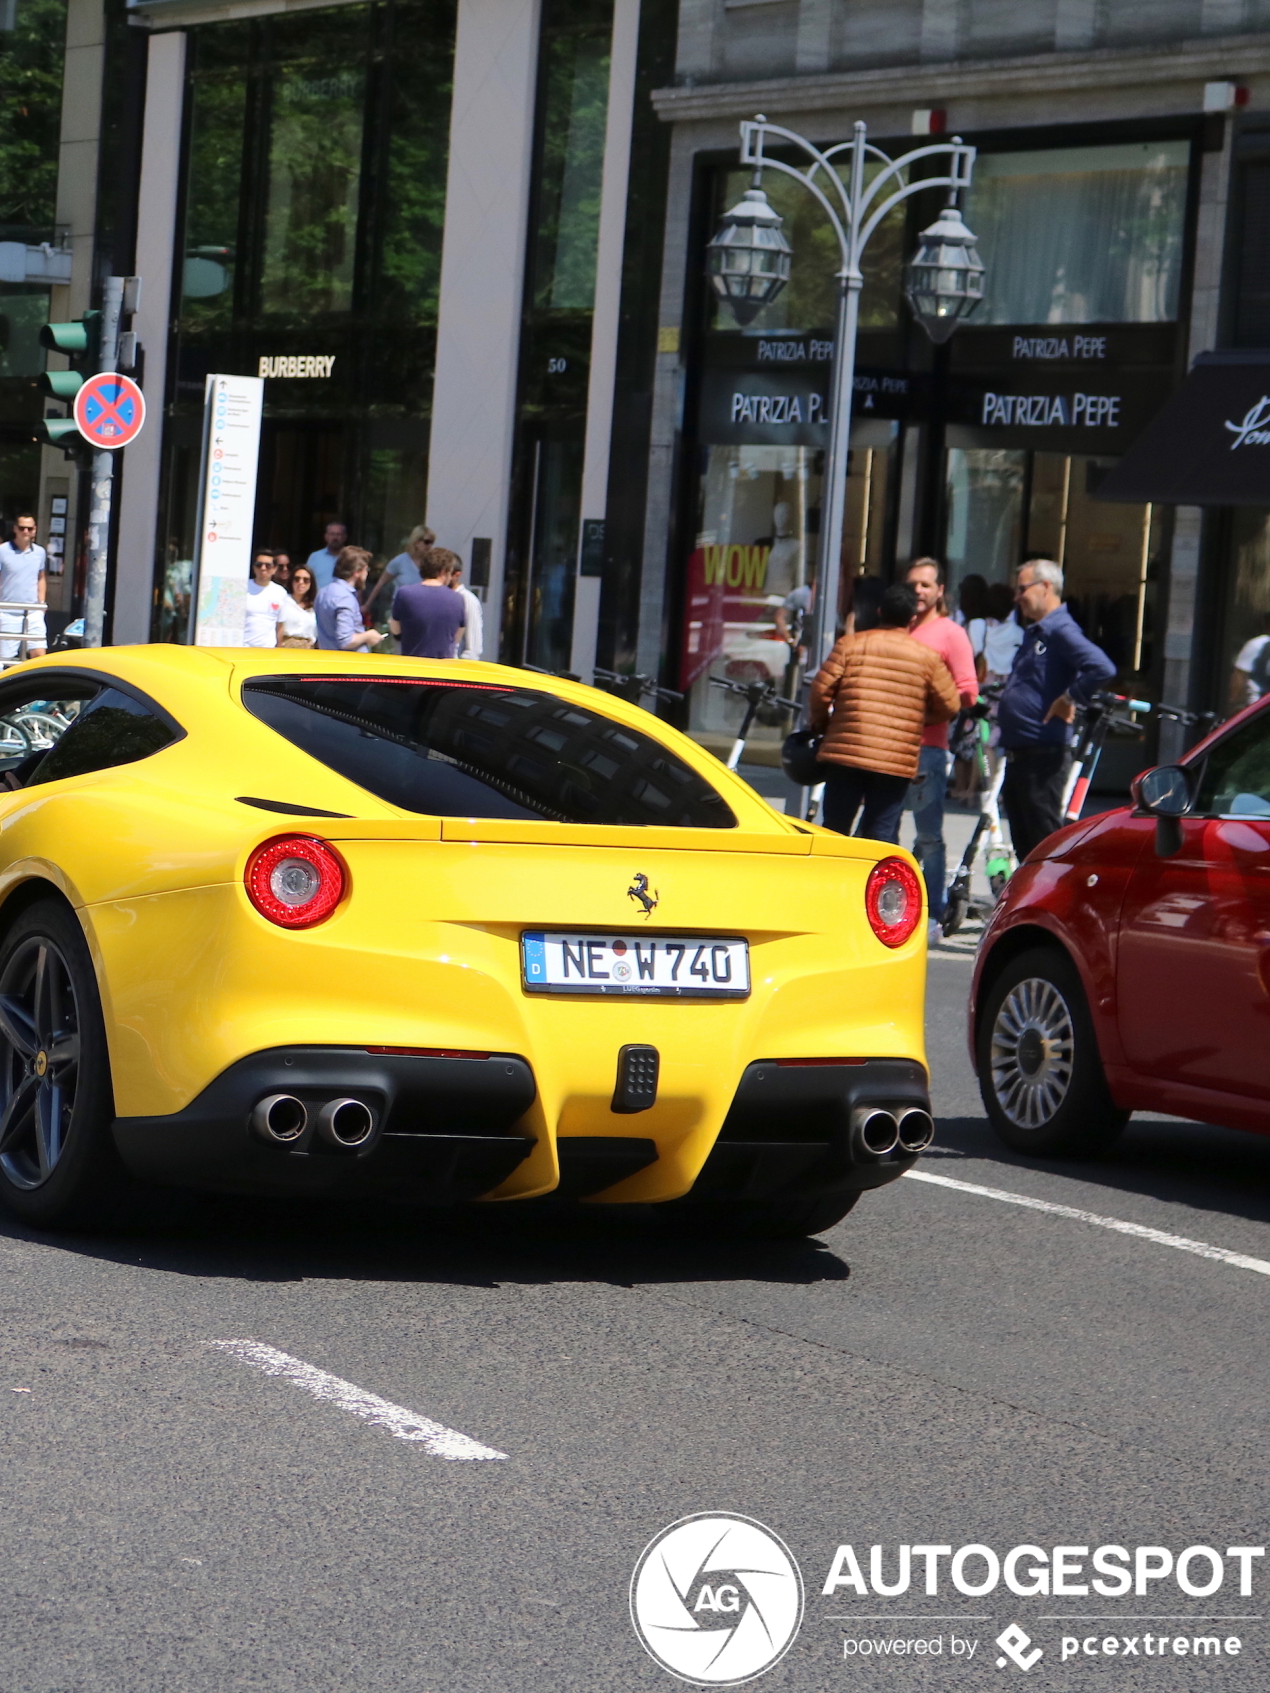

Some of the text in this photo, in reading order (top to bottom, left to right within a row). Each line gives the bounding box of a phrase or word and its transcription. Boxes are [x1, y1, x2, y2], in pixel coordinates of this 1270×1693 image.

[758, 340, 806, 361] PATRIZIA
[1013, 335, 1107, 359] PATRIZIA PEPE
[259, 355, 336, 378] BURBERRY
[548, 358, 566, 373] 50
[732, 393, 802, 424] PATRIZIA
[982, 392, 1121, 427] PATRIZIA PEPE
[704, 544, 770, 588] WOW
[532, 963, 541, 974] D
[562, 940, 731, 982] NE W 740
